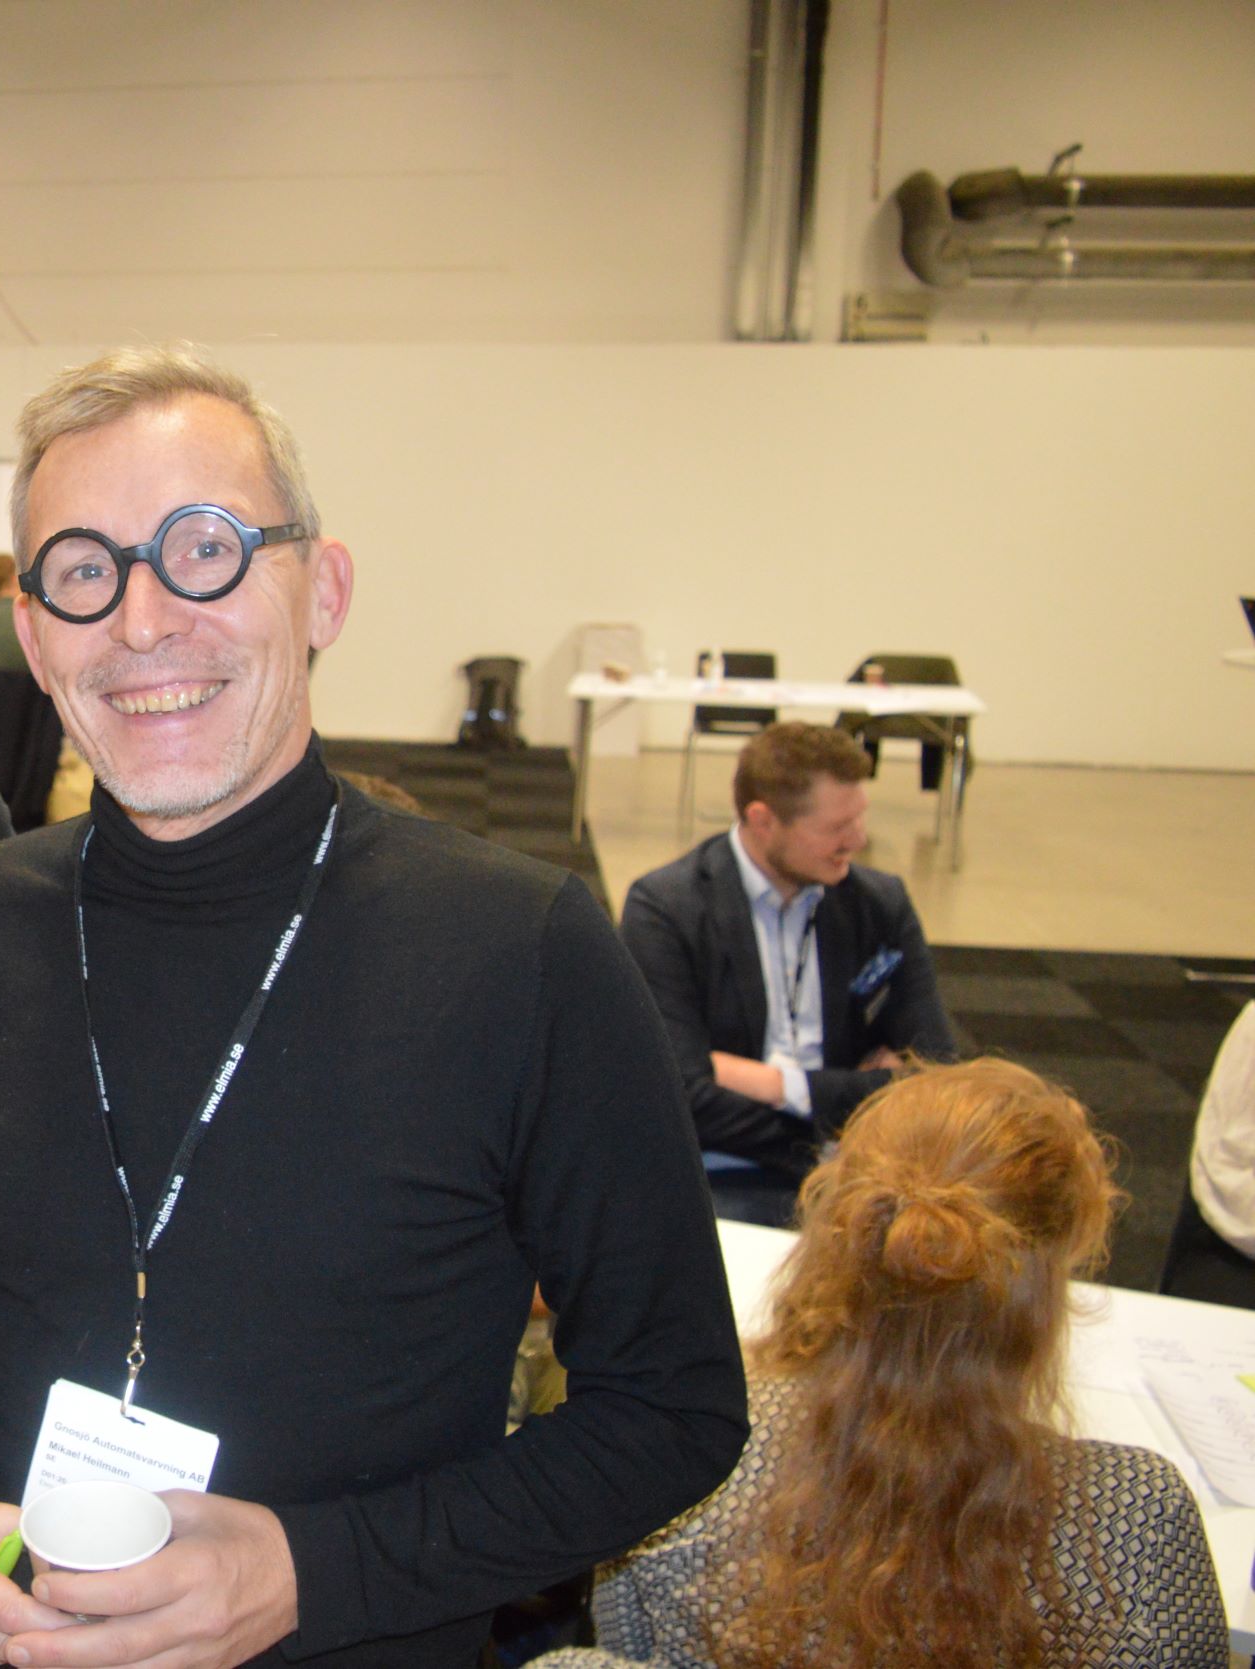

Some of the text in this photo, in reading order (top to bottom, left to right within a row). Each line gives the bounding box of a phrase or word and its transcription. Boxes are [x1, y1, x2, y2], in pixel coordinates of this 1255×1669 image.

[261, 914, 302, 990] www.elmia.se
[200, 1043, 244, 1123] www.elmia.se
[147, 1175, 184, 1250] www.elmia.se
[48, 1440, 81, 1463] Mikael
[92, 1435, 187, 1479] Automatsvarvning
[188, 1471, 206, 1484] AB
